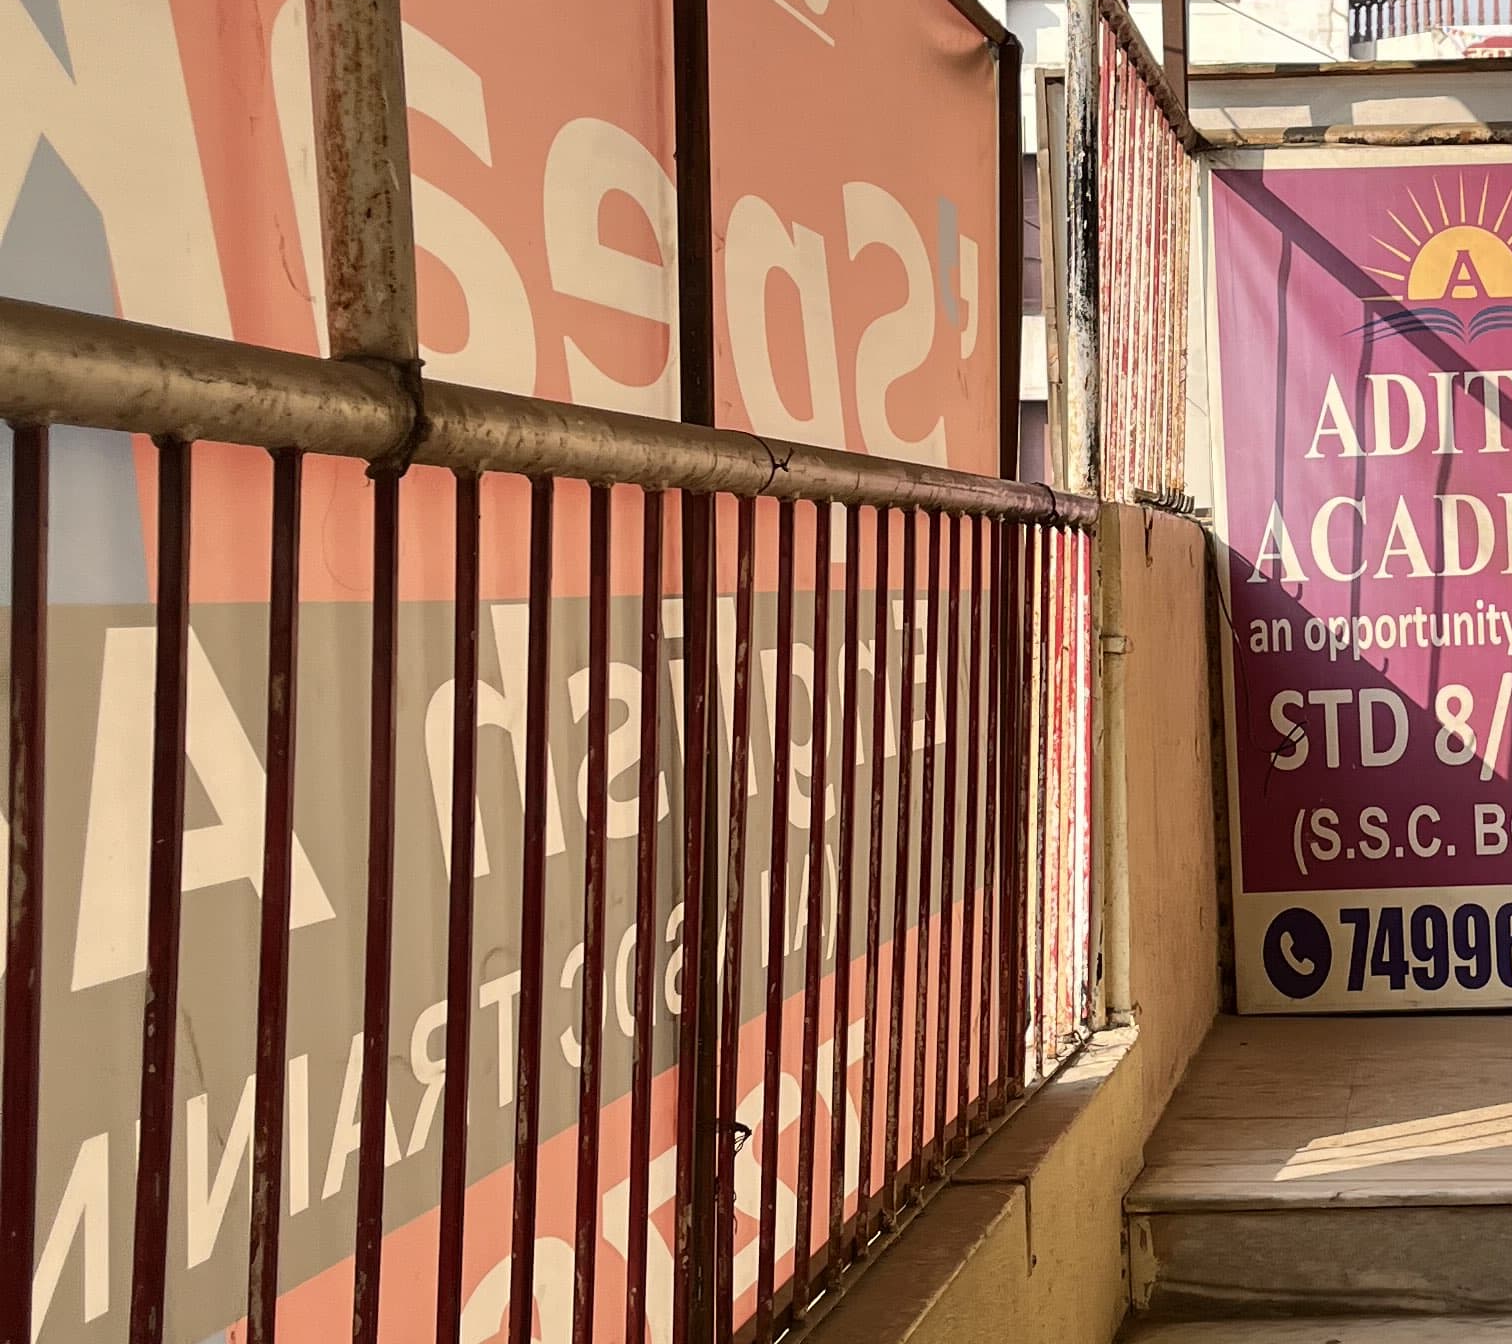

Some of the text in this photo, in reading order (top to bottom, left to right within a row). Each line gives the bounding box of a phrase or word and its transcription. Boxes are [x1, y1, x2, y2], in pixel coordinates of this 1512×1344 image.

[1249, 615, 1293, 655] an
[1269, 688, 1410, 772] STD
[1293, 805, 1457, 876] (S.S.C.
